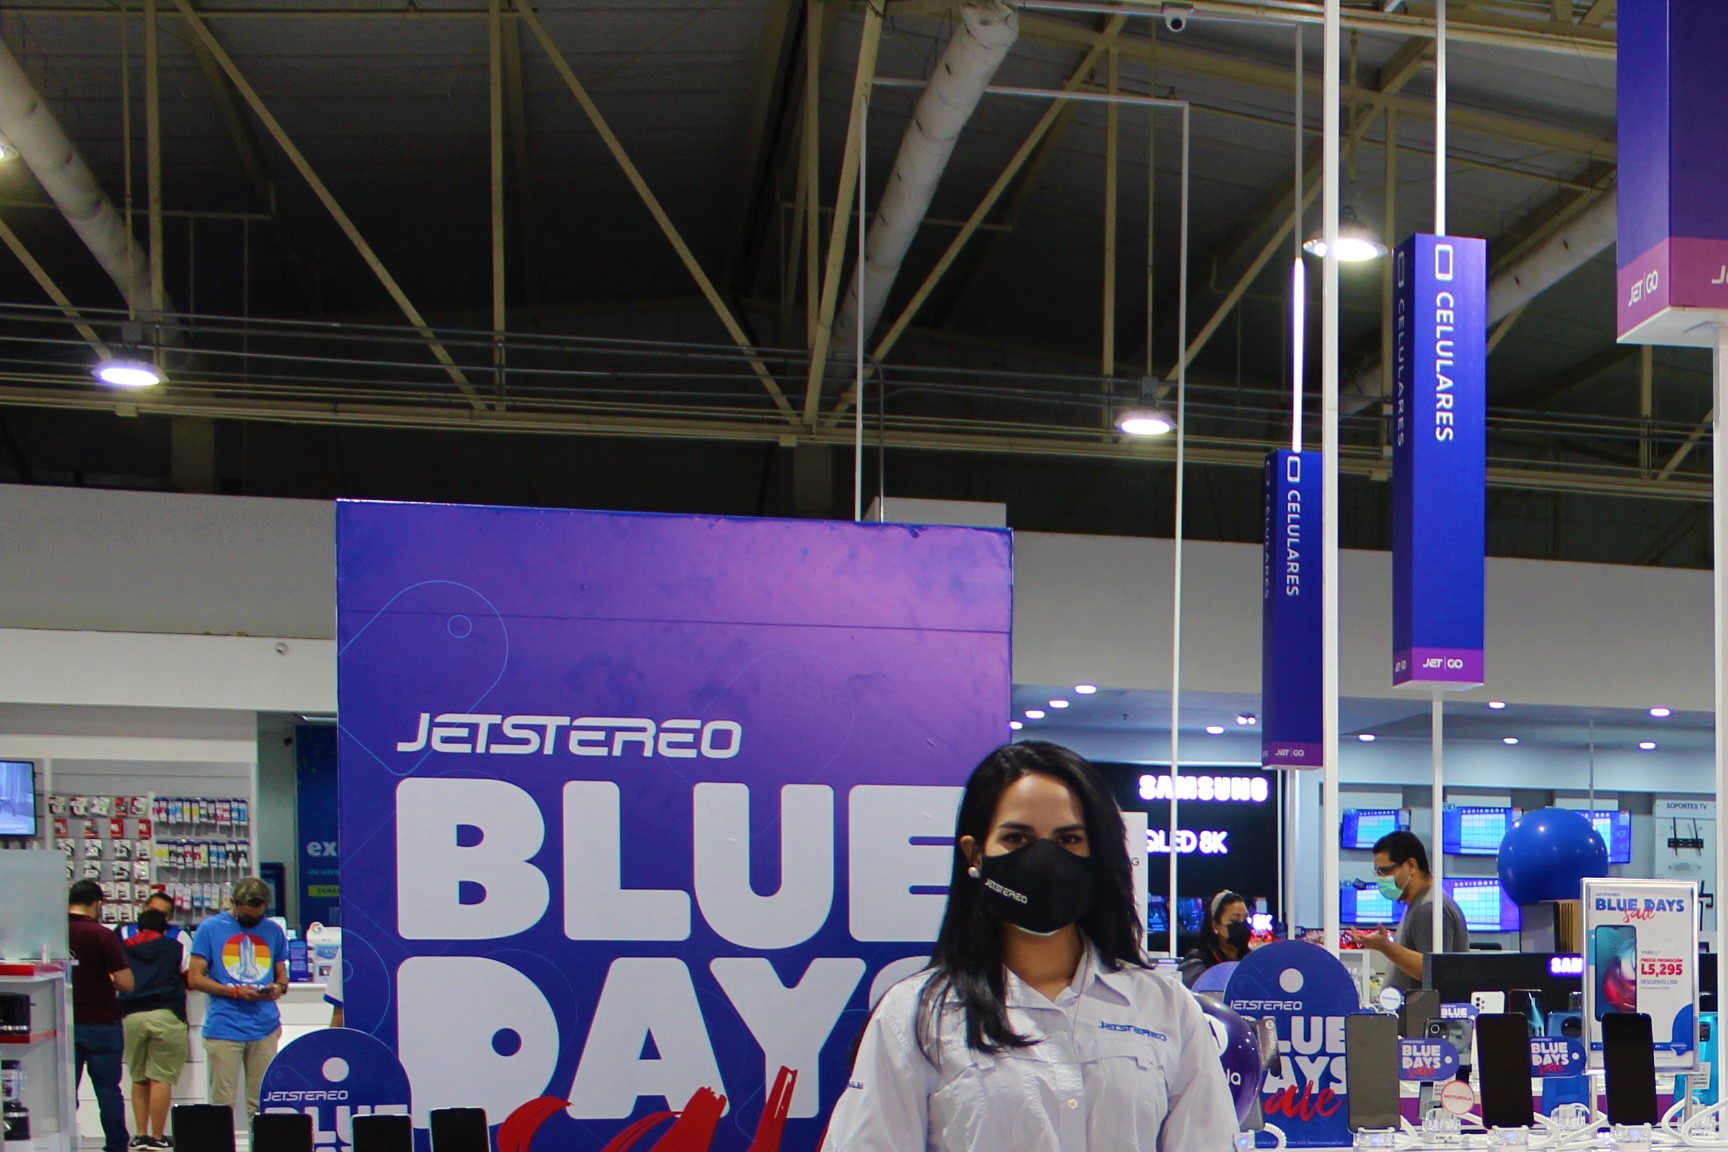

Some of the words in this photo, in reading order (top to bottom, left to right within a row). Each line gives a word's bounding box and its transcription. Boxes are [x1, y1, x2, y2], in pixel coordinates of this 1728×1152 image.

[1628, 279, 1644, 307] JET
[1646, 270, 1659, 295] GO
[1435, 290, 1455, 443] CELULARES
[1286, 489, 1301, 597] CELULARES
[1422, 657, 1444, 669] JET
[1447, 658, 1464, 669] GO
[396, 712, 743, 759] JETSTEREO
[1139, 775, 1268, 802] SAMSUNG
[1199, 831, 1229, 854] 8K
[396, 777, 966, 950] BLUE
[984, 879, 1028, 904] JETSTEREO
[1595, 898, 1638, 911] BLUE
[1644, 898, 1684, 912] DAYS
[1641, 962, 1683, 977] L5,295
[1441, 1008, 1468, 1018] BLUE
[397, 956, 930, 1128] DAY
[1098, 1021, 1167, 1042] JETSTEREO
[1240, 1015, 1346, 1055] LUE
[1402, 1045, 1440, 1056] BLUE
[1531, 1042, 1568, 1054] BLUE
[1402, 1057, 1441, 1069] DAYS
[1532, 1054, 1569, 1066] DAYS
[1262, 1056, 1347, 1094] AYS
[263, 1090, 348, 1101] JETSTEREO
